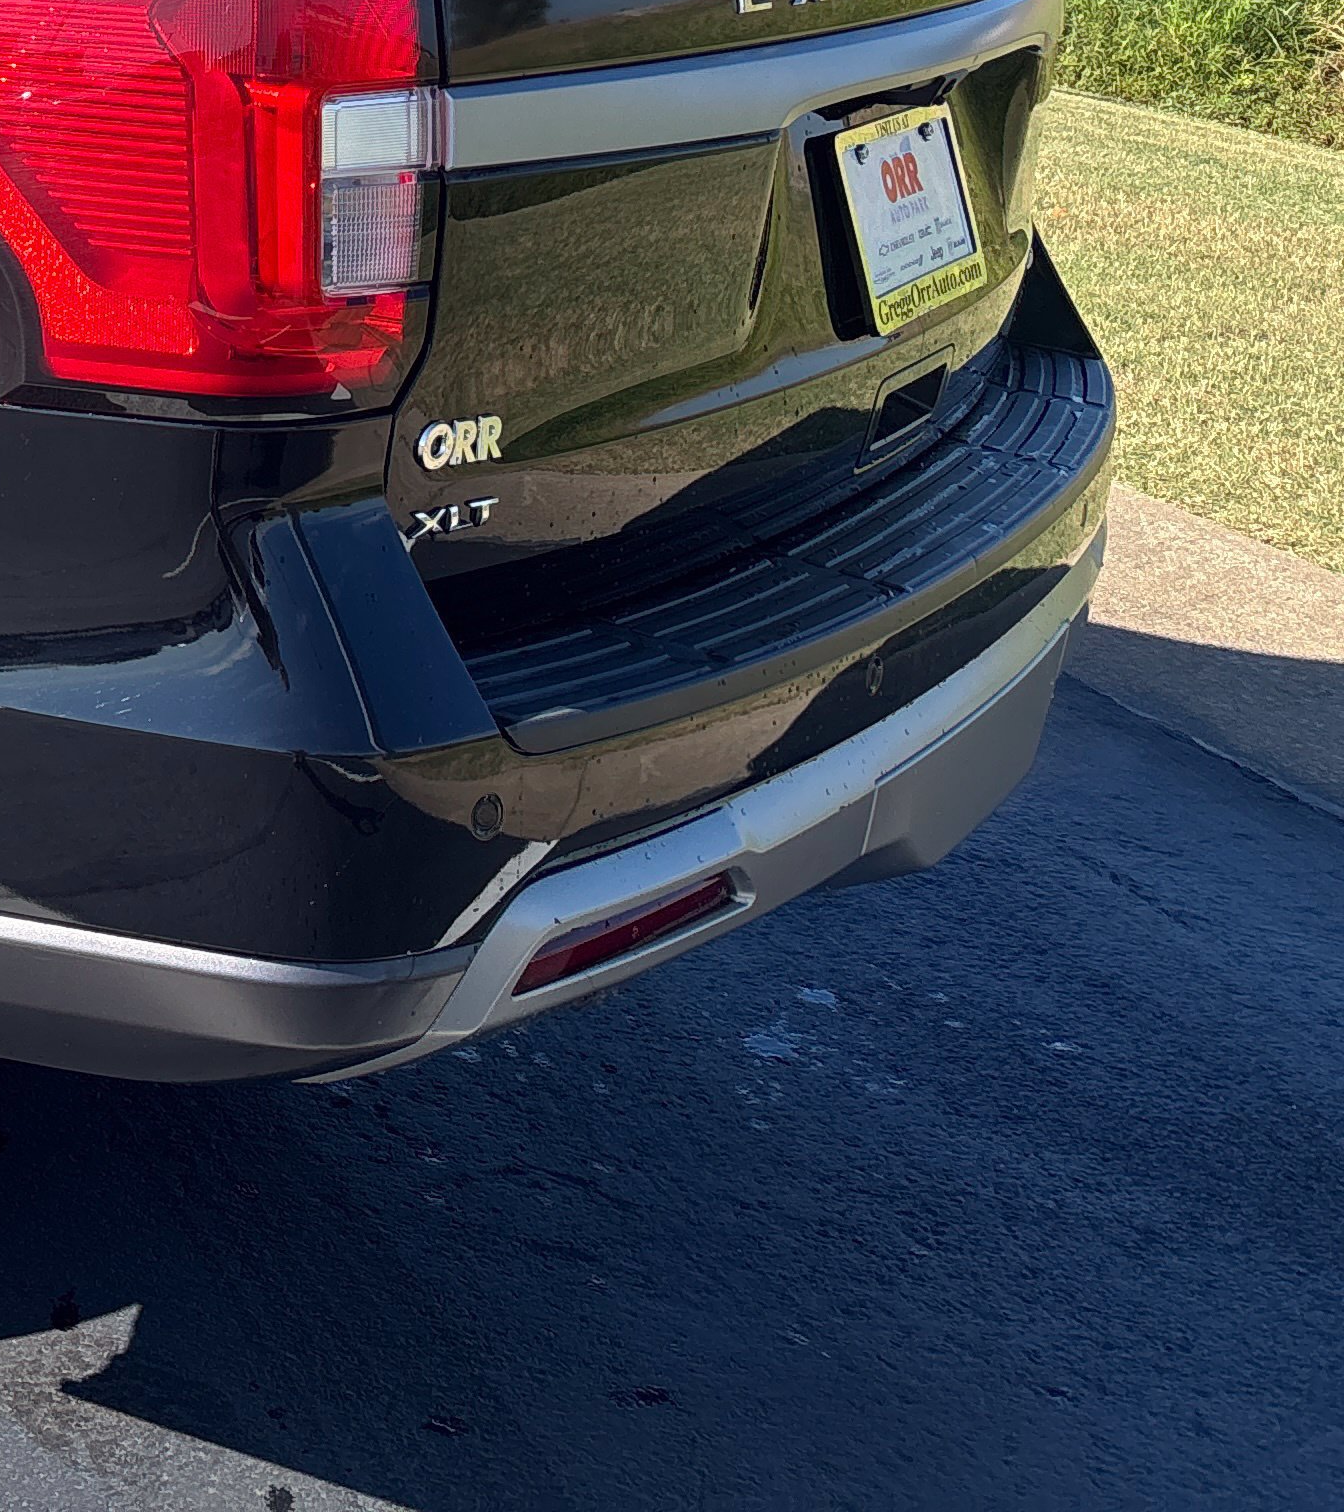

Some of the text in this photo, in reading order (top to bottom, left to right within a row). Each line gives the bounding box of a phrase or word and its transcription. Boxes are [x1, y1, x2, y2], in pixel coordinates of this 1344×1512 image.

[880, 151, 924, 204] ORR
[878, 261, 983, 326] GreggOrrAuto.com
[417, 414, 503, 470] ORR
[408, 496, 501, 540] XLT
